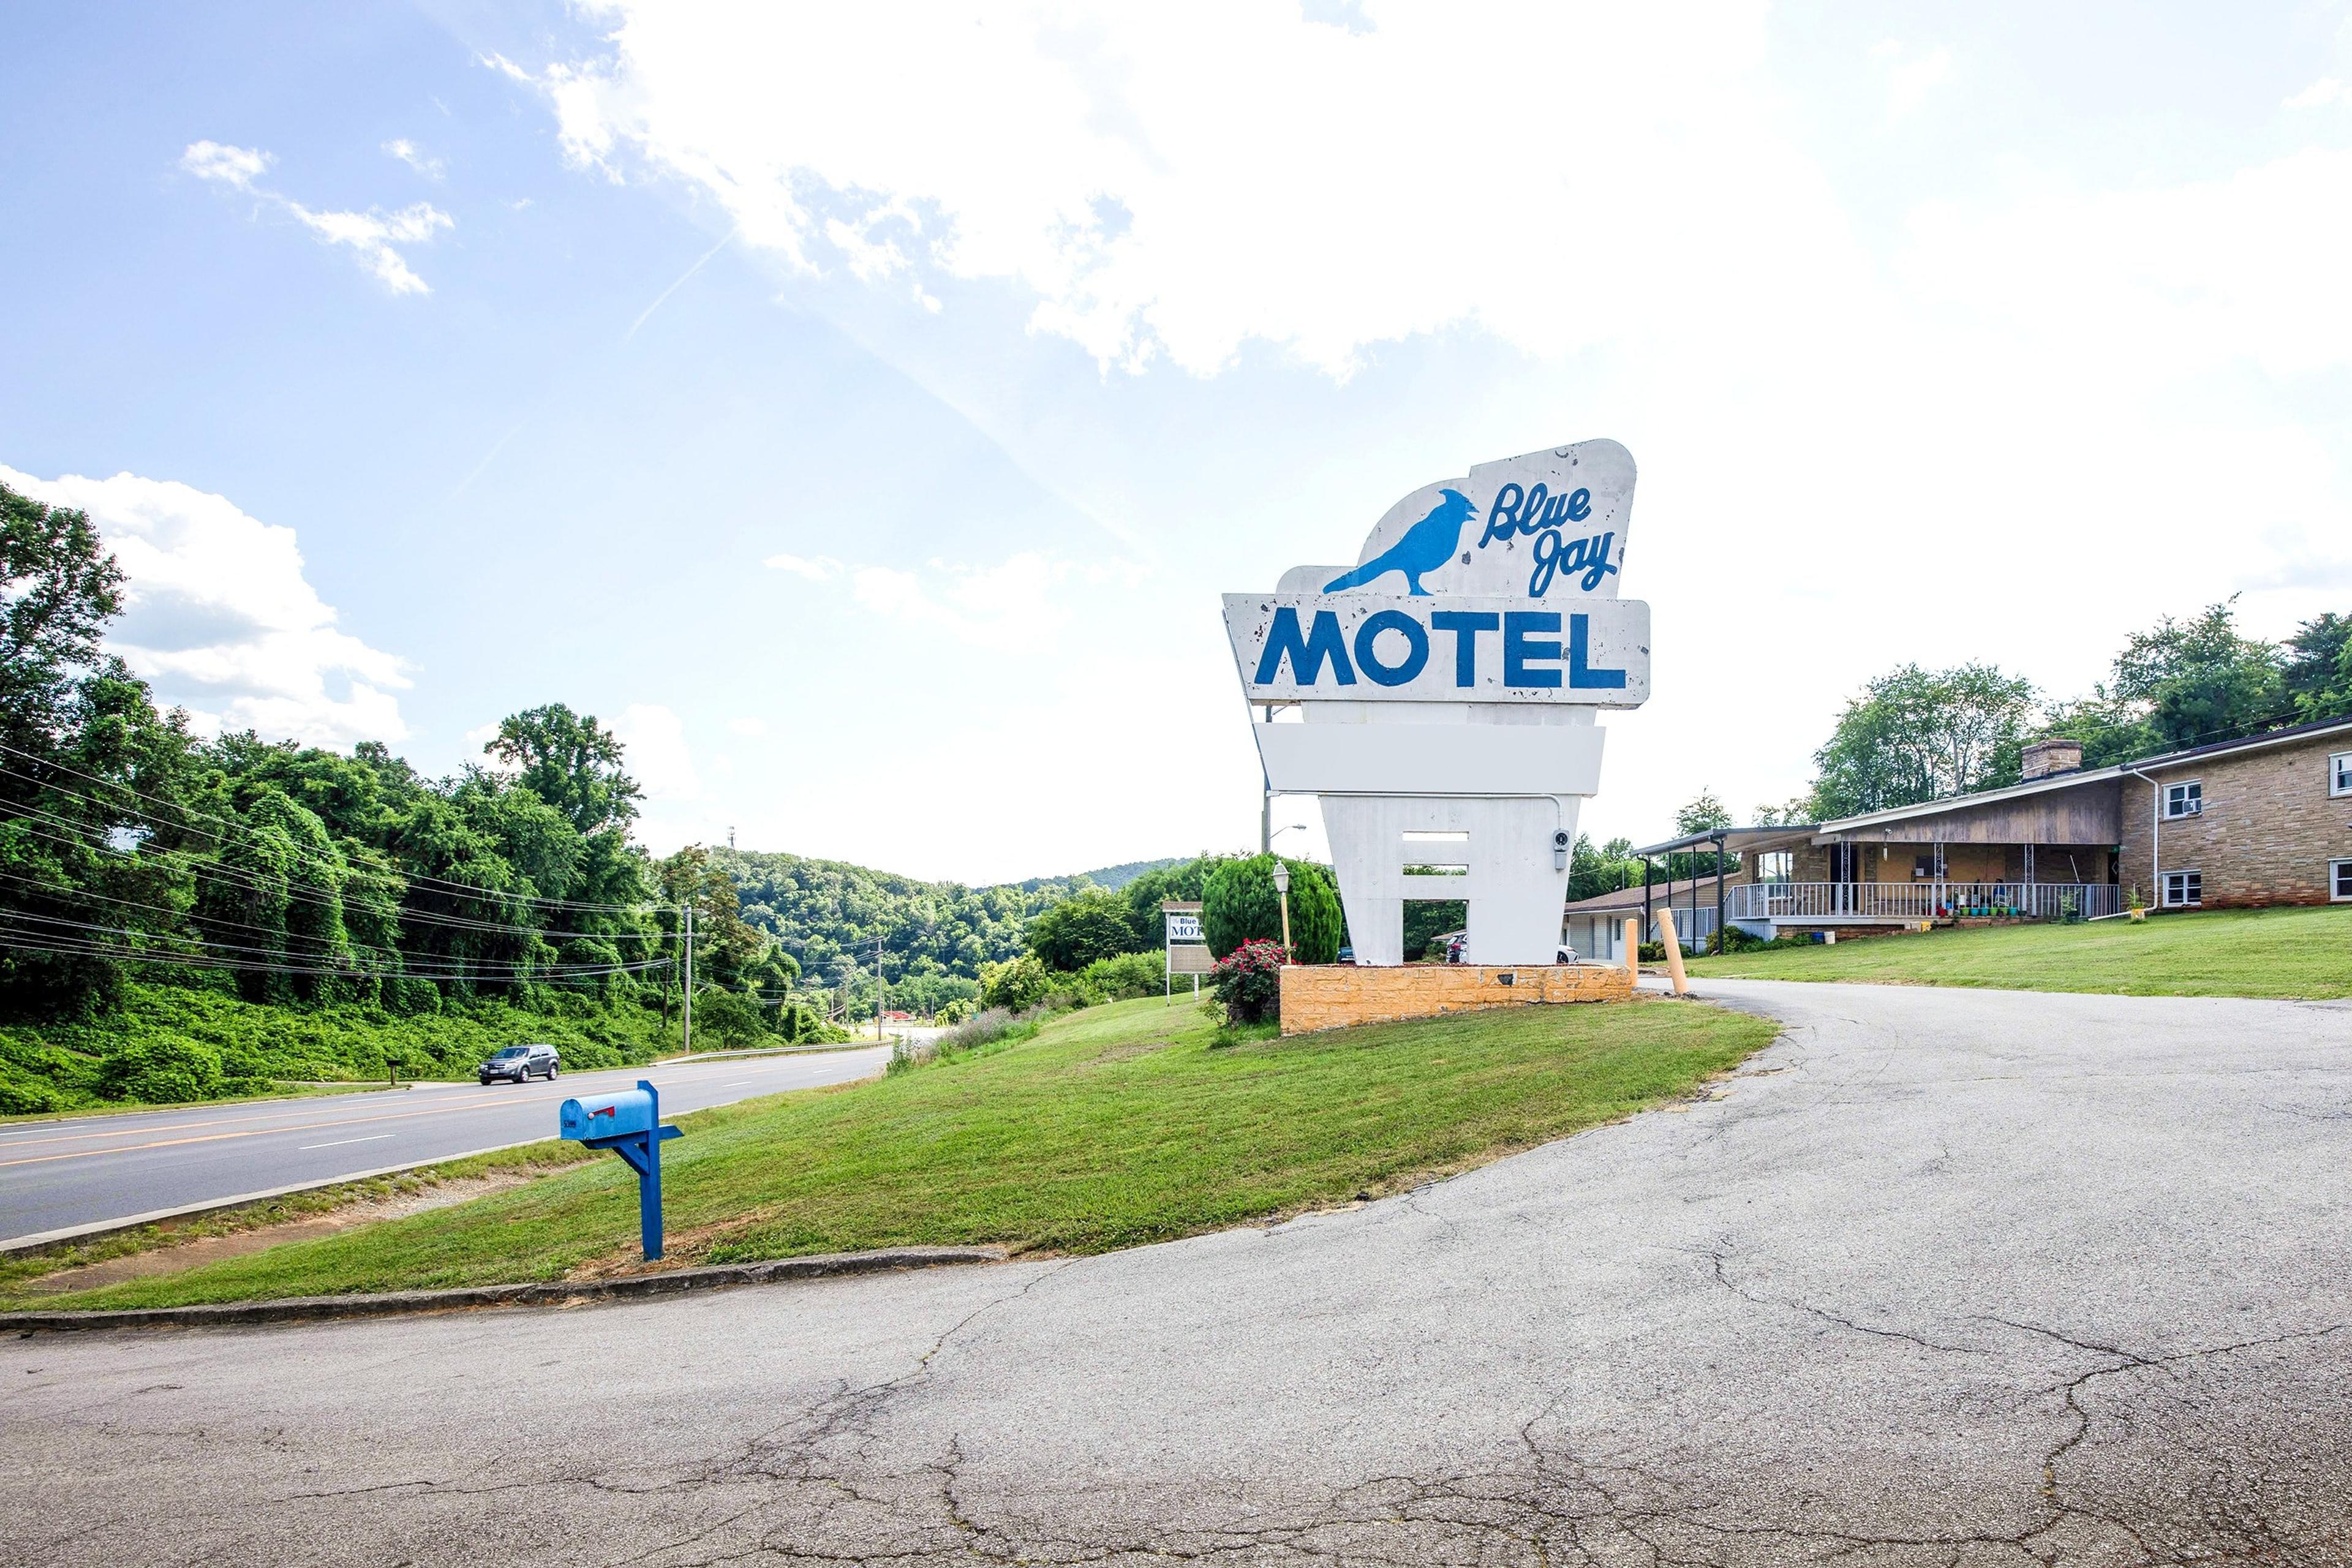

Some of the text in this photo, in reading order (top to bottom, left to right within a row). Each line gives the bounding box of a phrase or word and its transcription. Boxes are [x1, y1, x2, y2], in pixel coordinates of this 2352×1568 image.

[1478, 483, 1591, 549] Blue
[1528, 529, 1618, 598] Jay
[1254, 606, 1626, 689] MOTEL
